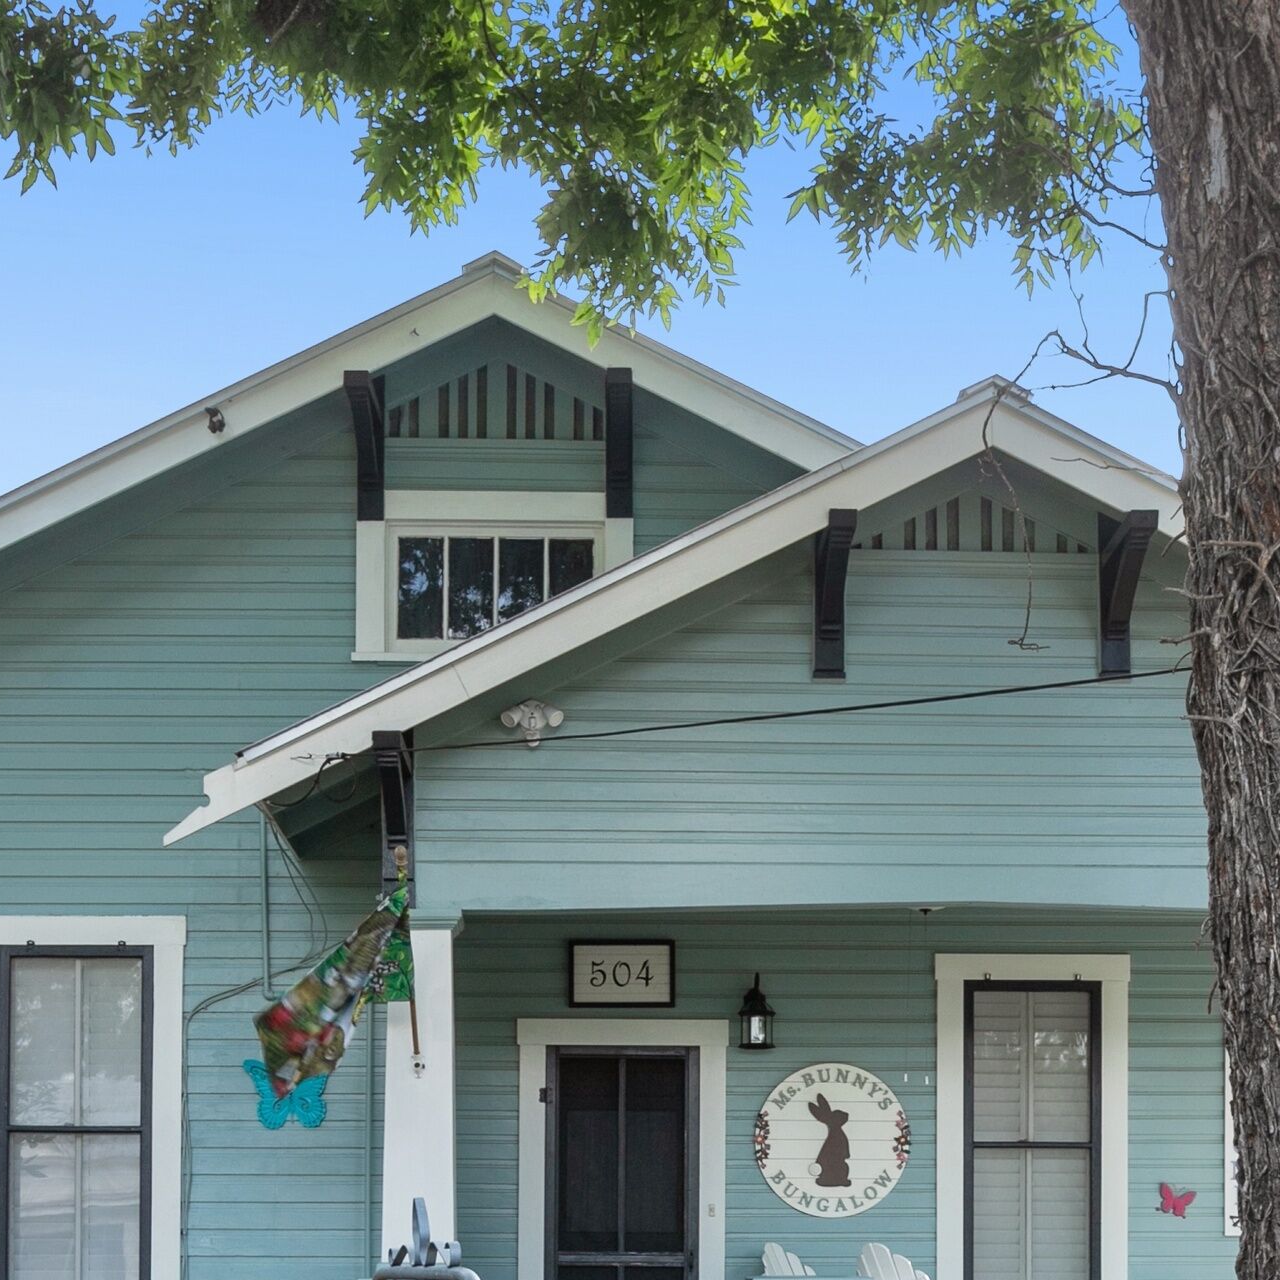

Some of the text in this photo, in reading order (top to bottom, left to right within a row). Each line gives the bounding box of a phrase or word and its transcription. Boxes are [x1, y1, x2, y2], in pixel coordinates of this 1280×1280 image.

[589, 959, 655, 988] 504
[770, 1067, 894, 1111] Ms. BUNNY'S
[770, 1168, 894, 1213] BUNGALOW
